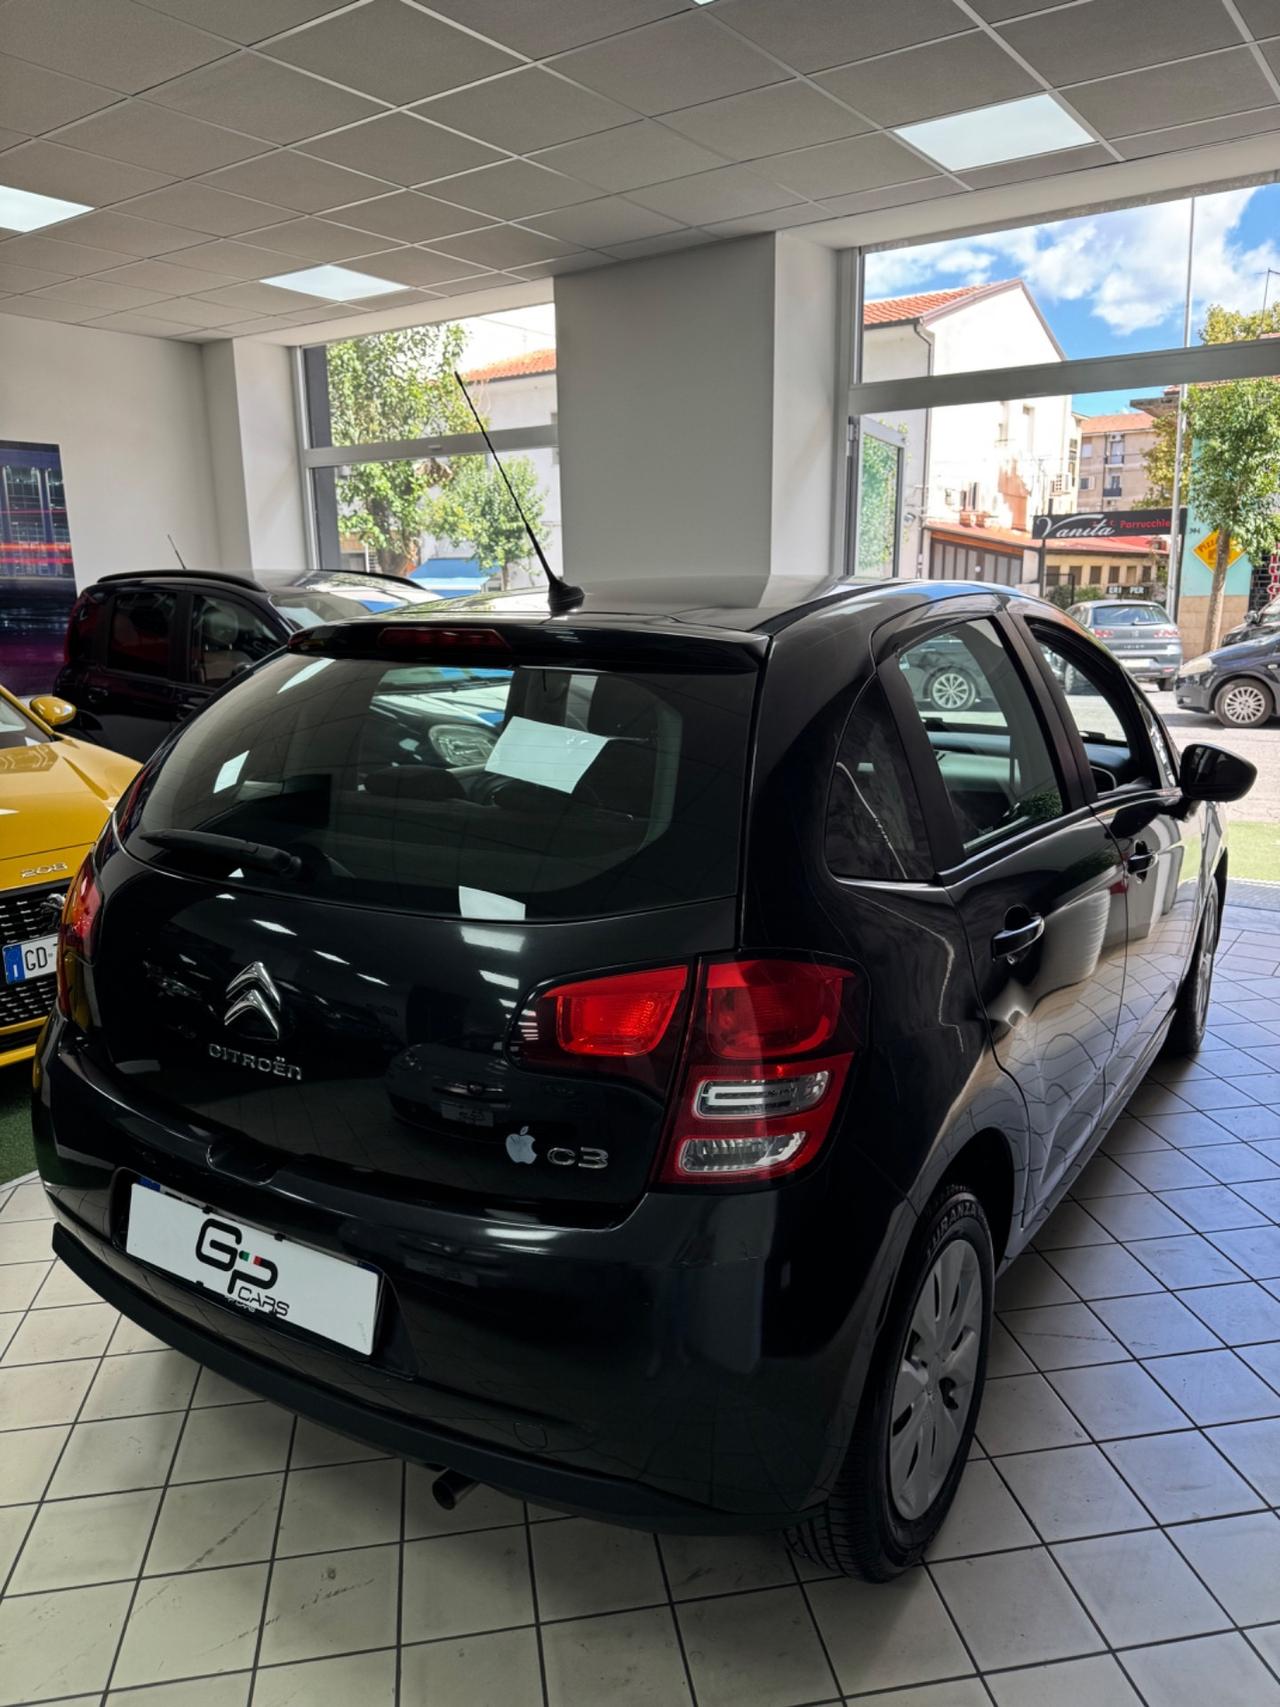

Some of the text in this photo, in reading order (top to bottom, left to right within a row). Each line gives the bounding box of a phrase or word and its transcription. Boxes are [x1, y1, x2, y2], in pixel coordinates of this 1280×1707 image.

[1120, 518, 1171, 530] Parrucchie
[547, 1146, 609, 1169] C3
[237, 1286, 290, 1318] CARS
